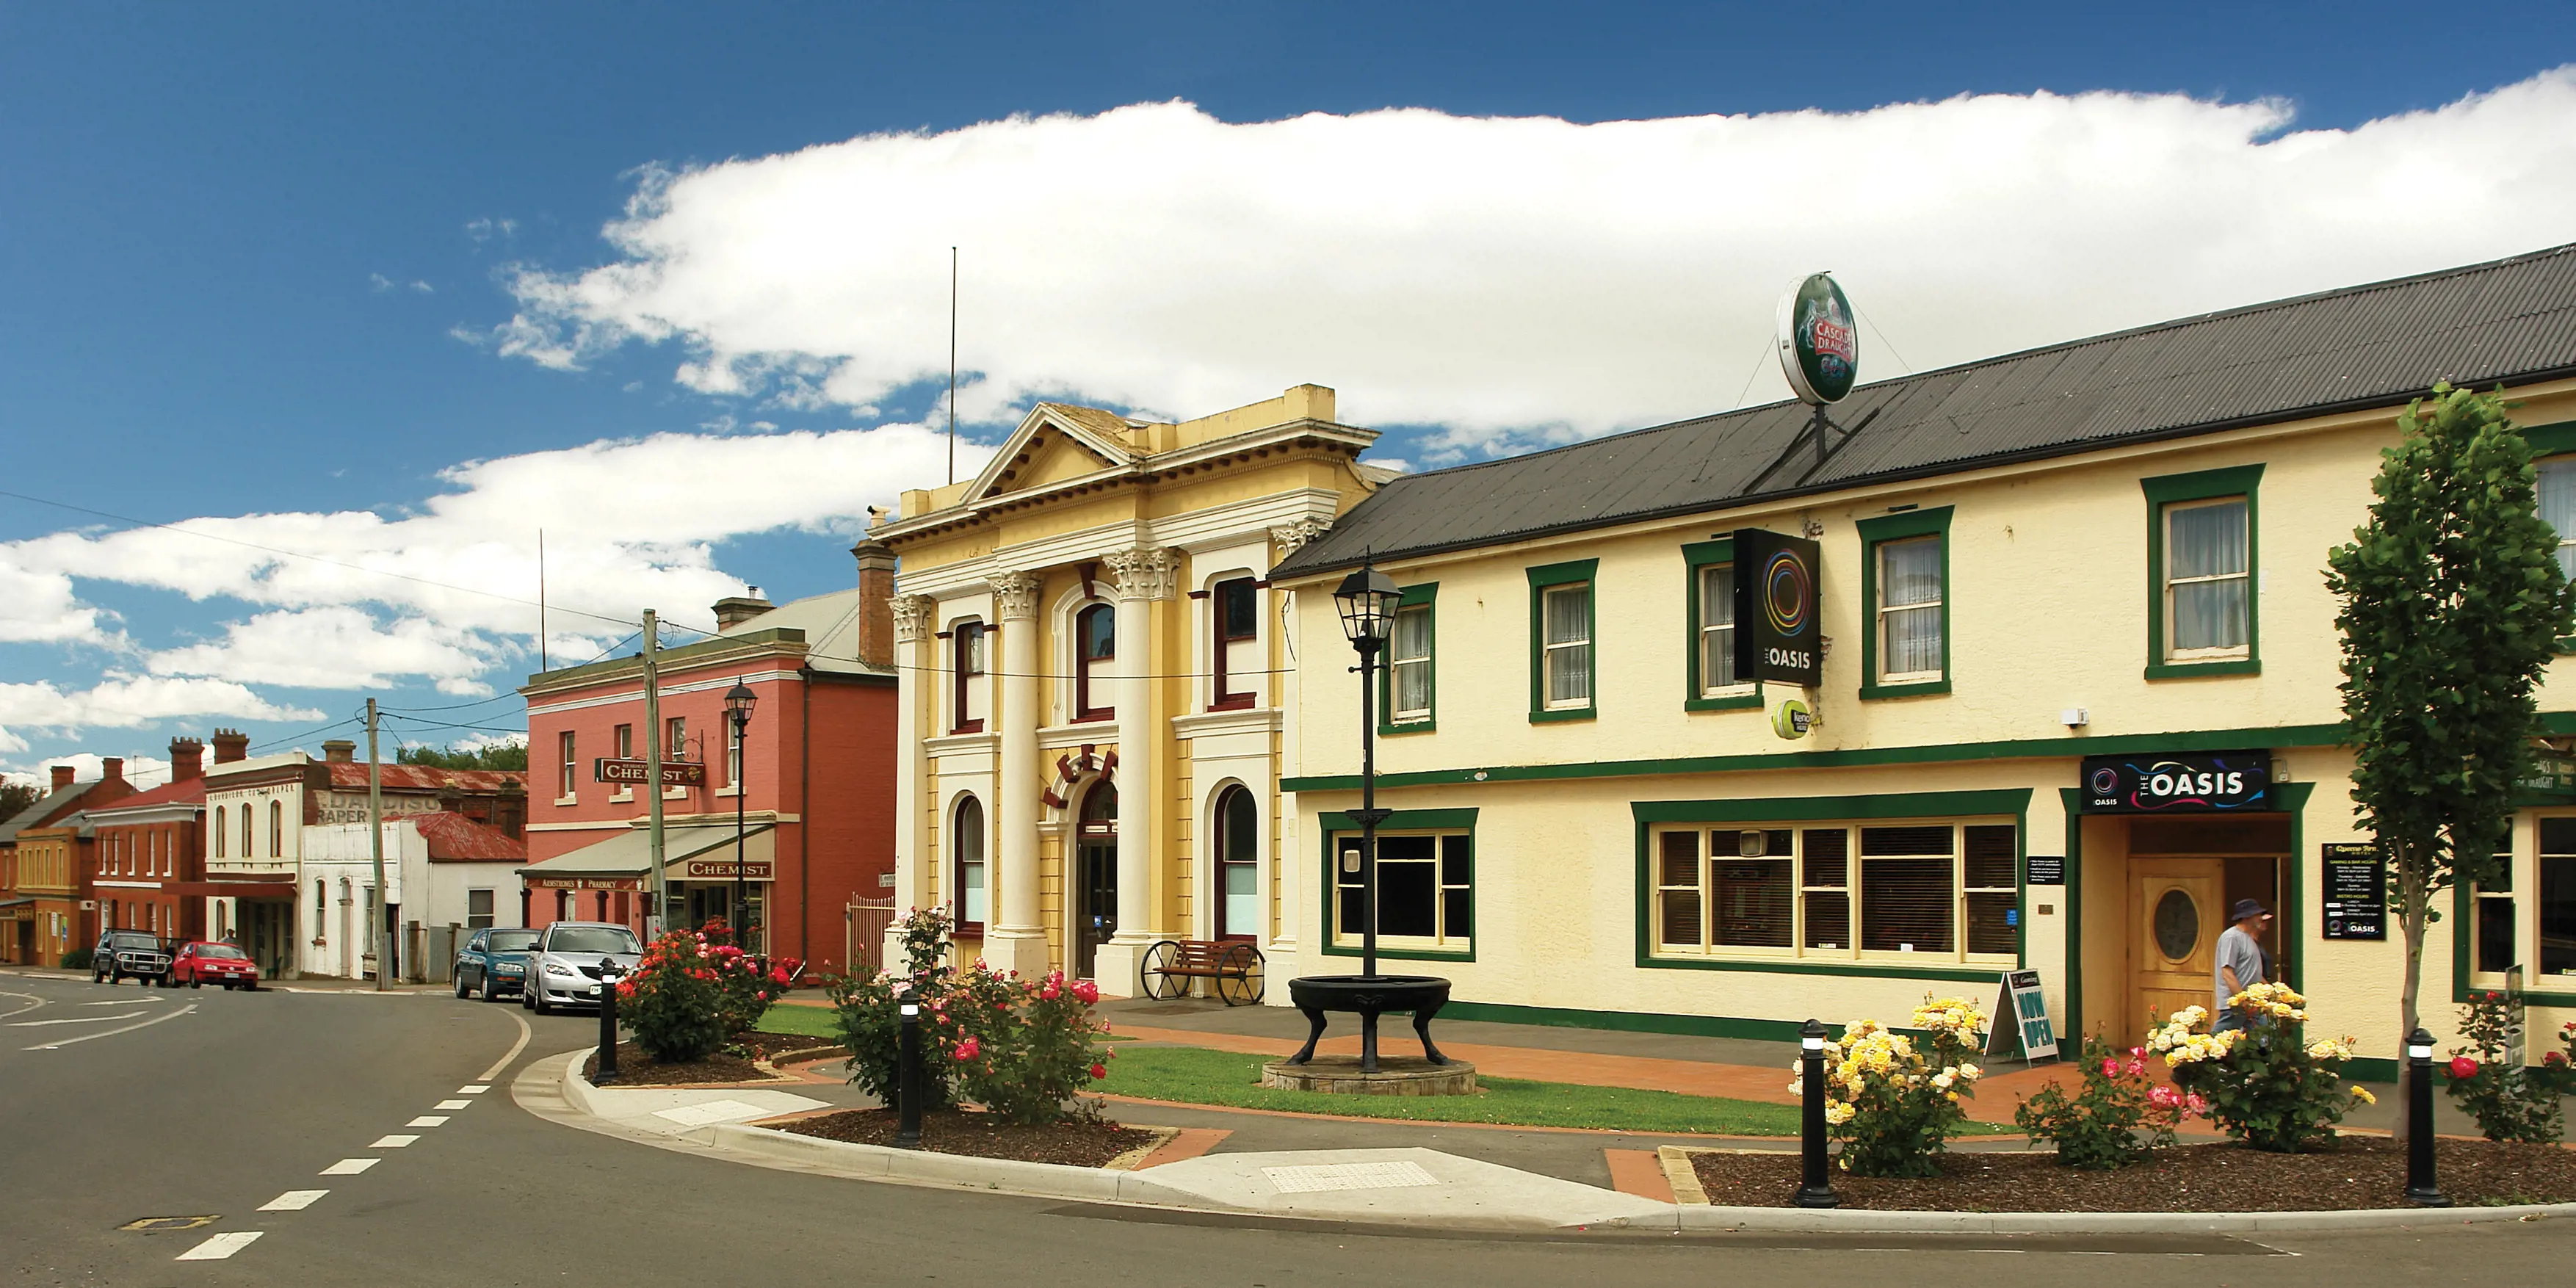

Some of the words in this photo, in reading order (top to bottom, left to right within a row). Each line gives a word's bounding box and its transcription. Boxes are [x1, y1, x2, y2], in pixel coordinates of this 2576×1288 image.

[1818, 337, 1851, 358] DRAUGHT
[1770, 648, 1810, 669] OASIS
[1794, 711, 1810, 723] keno
[607, 764, 683, 781] CHEST
[2140, 775, 2149, 797] THE
[2150, 771, 2243, 797] OASIS
[588, 880, 617, 889] PHARMACY
[2017, 991, 2044, 1019] NOW
[2024, 1019, 2054, 1048] OPEN
